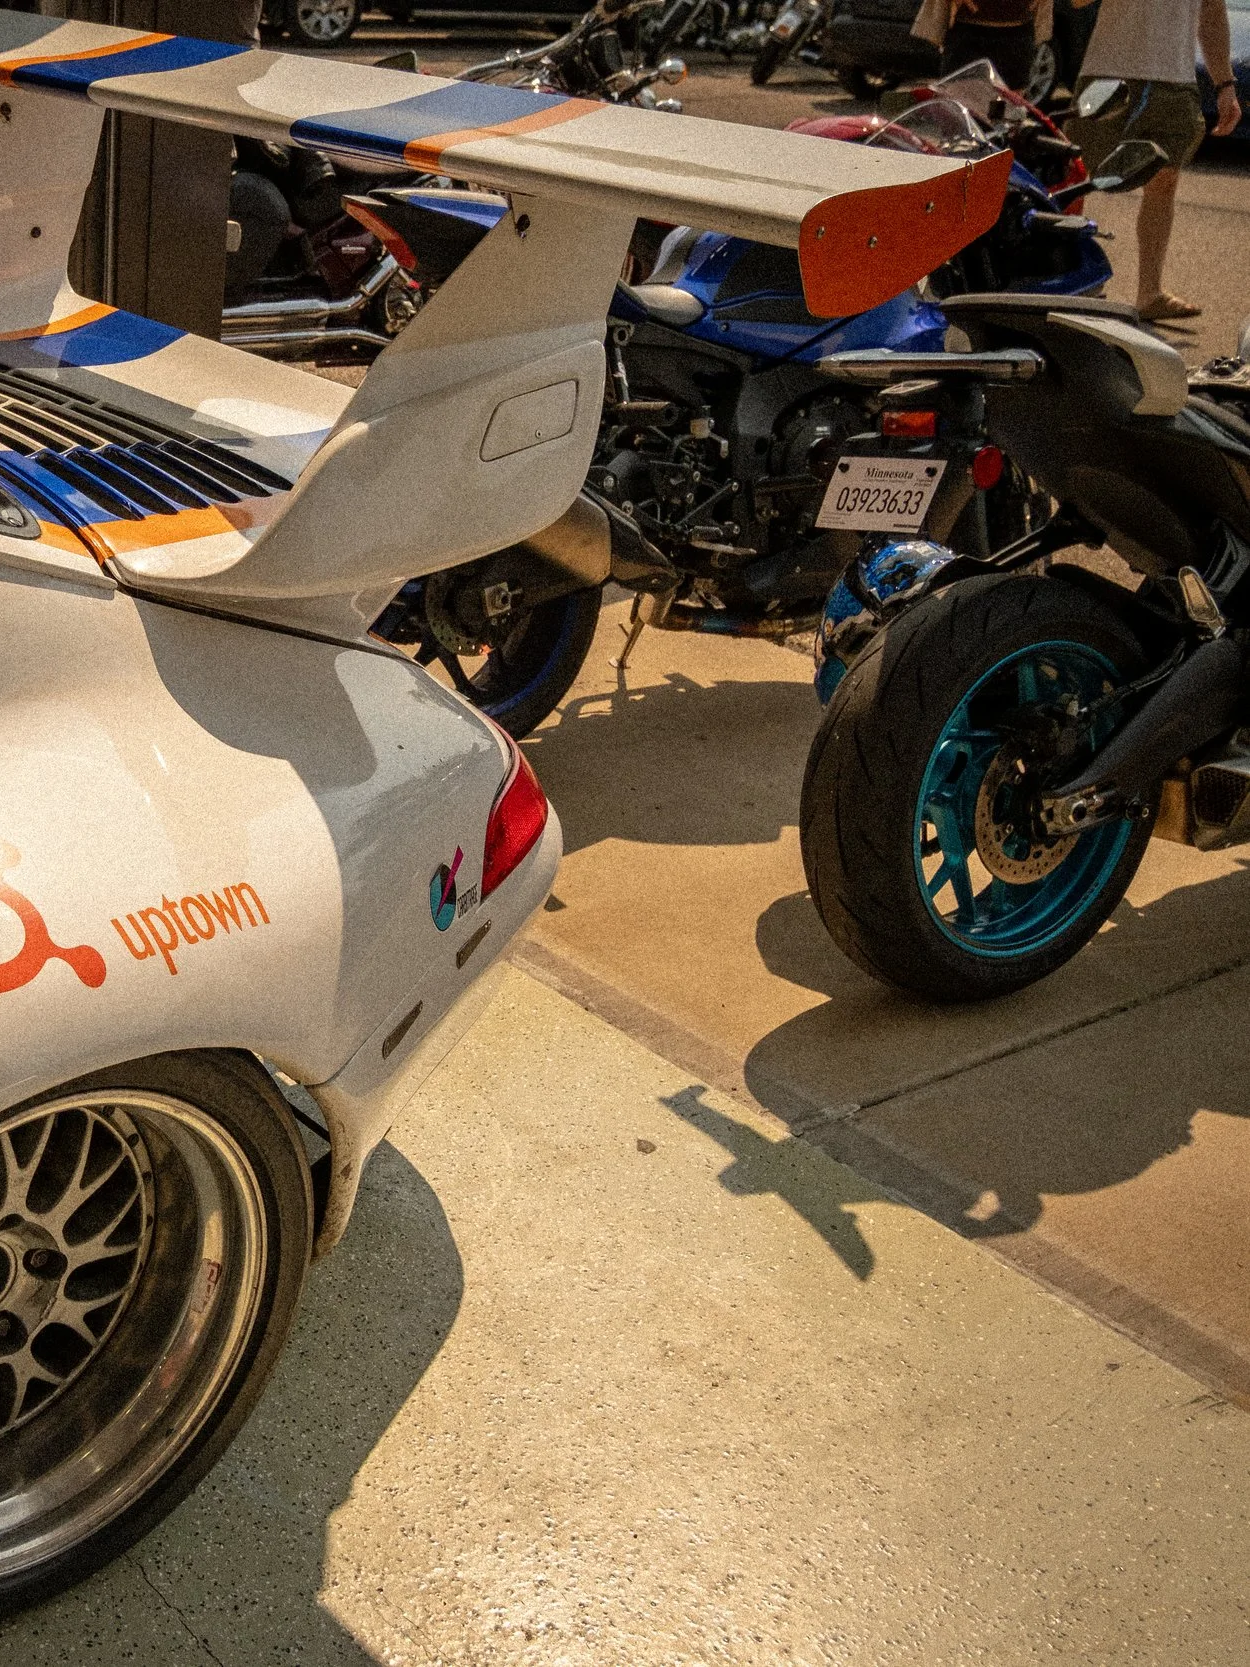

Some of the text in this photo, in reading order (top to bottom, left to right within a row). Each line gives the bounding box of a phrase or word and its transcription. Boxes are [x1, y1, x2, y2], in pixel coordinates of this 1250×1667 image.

[865, 467, 914, 480] Minnesota
[836, 487, 924, 515] 03923633
[110, 882, 270, 976] uptown
